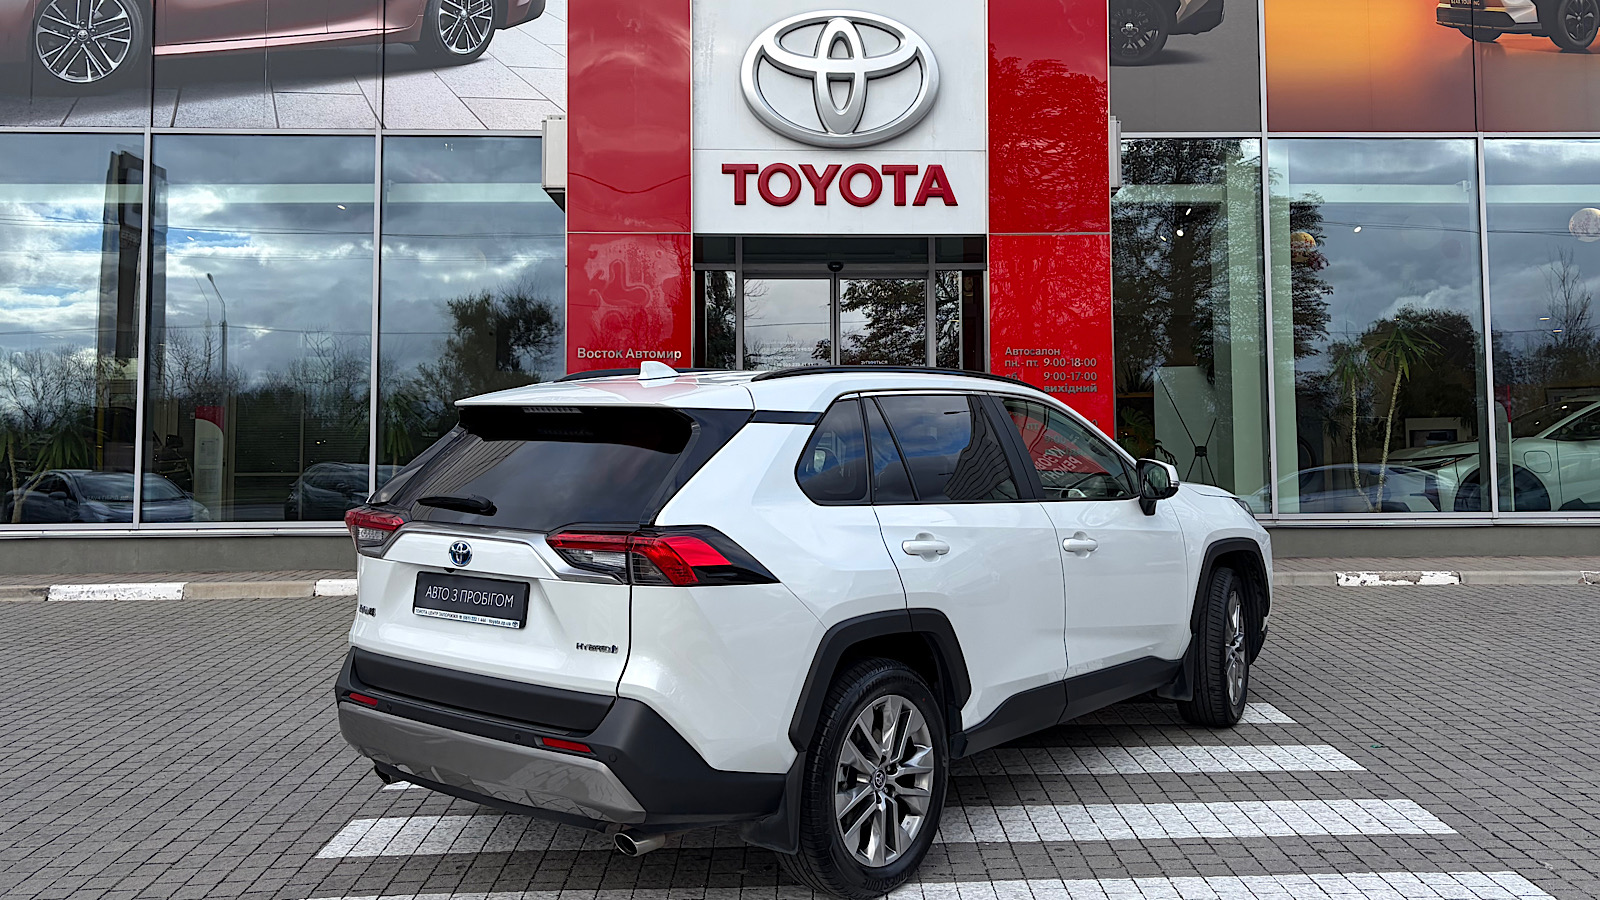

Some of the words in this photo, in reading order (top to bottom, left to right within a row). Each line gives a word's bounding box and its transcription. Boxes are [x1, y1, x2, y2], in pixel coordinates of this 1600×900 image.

[721, 162, 959, 207] TOYOTA
[577, 347, 623, 359] Восток
[625, 348, 682, 361] Автомир
[1005, 346, 1061, 356] Автосалон
[1043, 372, 1098, 381] 9:00-17:00
[1043, 383, 1098, 394] вихідний
[425, 585, 450, 601] АВТО
[459, 589, 515, 608] ПРОБІГОМ
[576, 642, 611, 653] HYBRID
